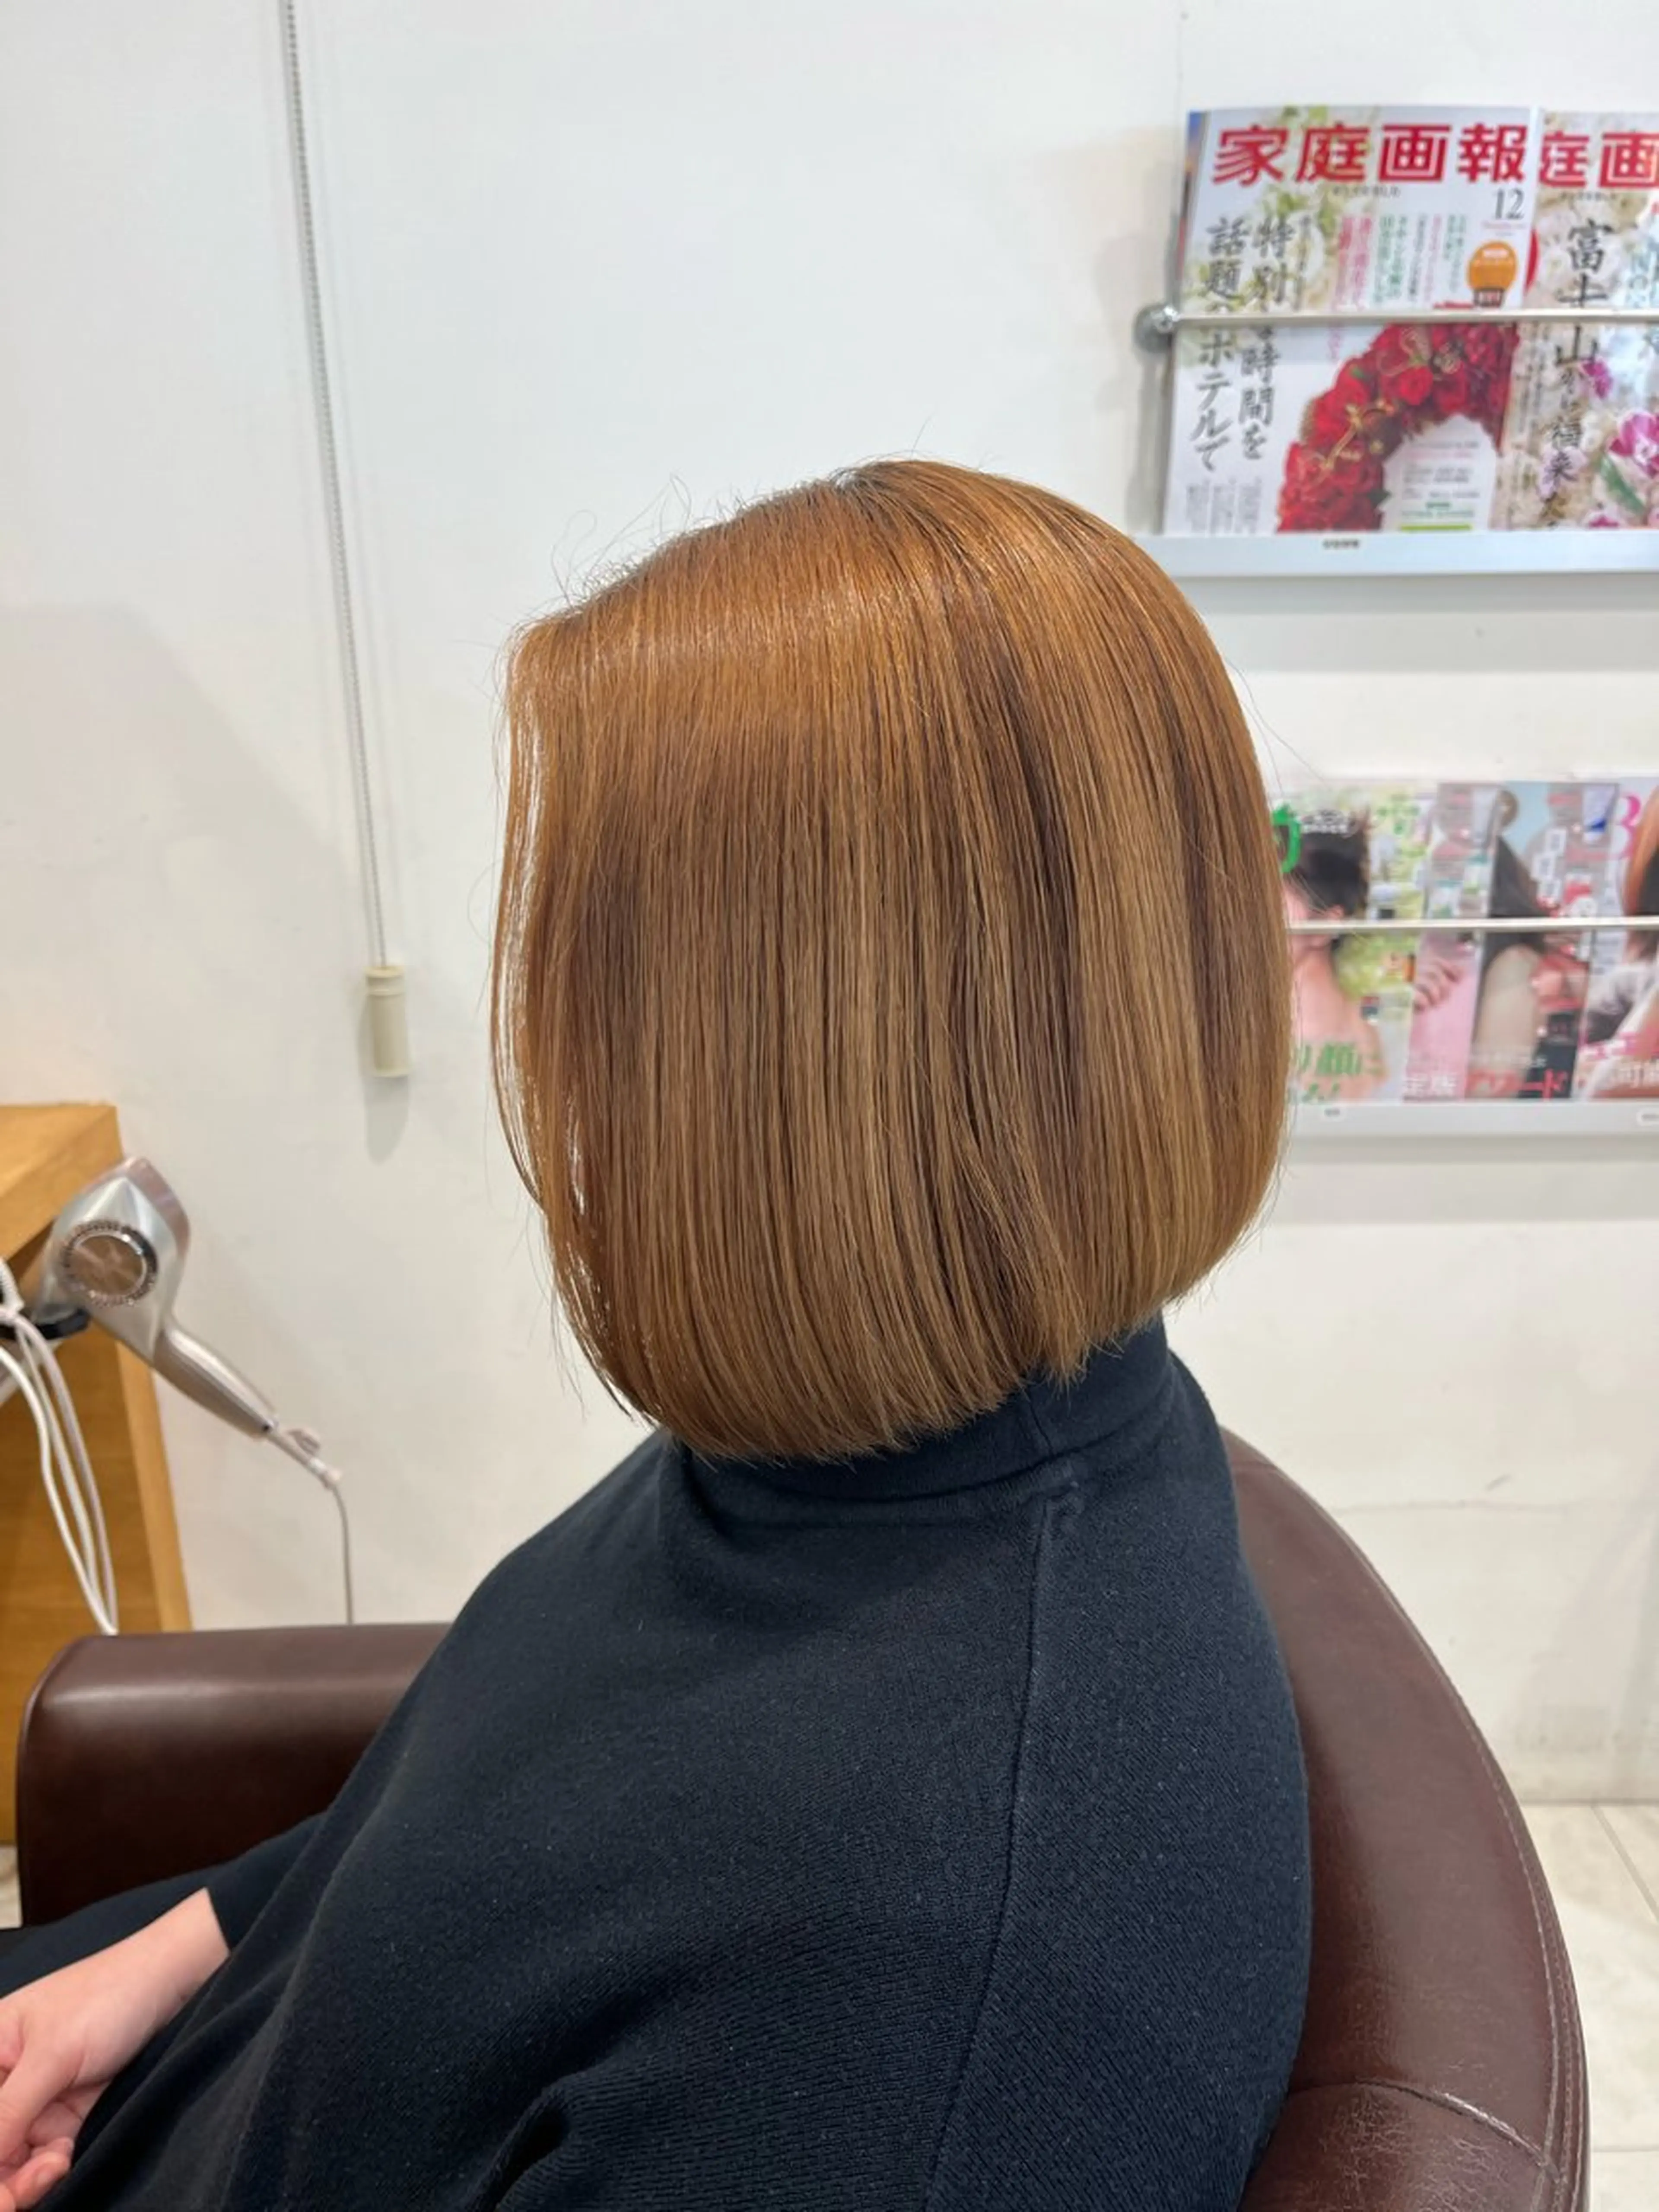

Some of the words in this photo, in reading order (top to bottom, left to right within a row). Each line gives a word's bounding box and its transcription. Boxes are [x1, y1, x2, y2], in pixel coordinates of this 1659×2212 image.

[1212, 123, 1528, 188] 家庭画報
[1493, 188, 1525, 220] 12
